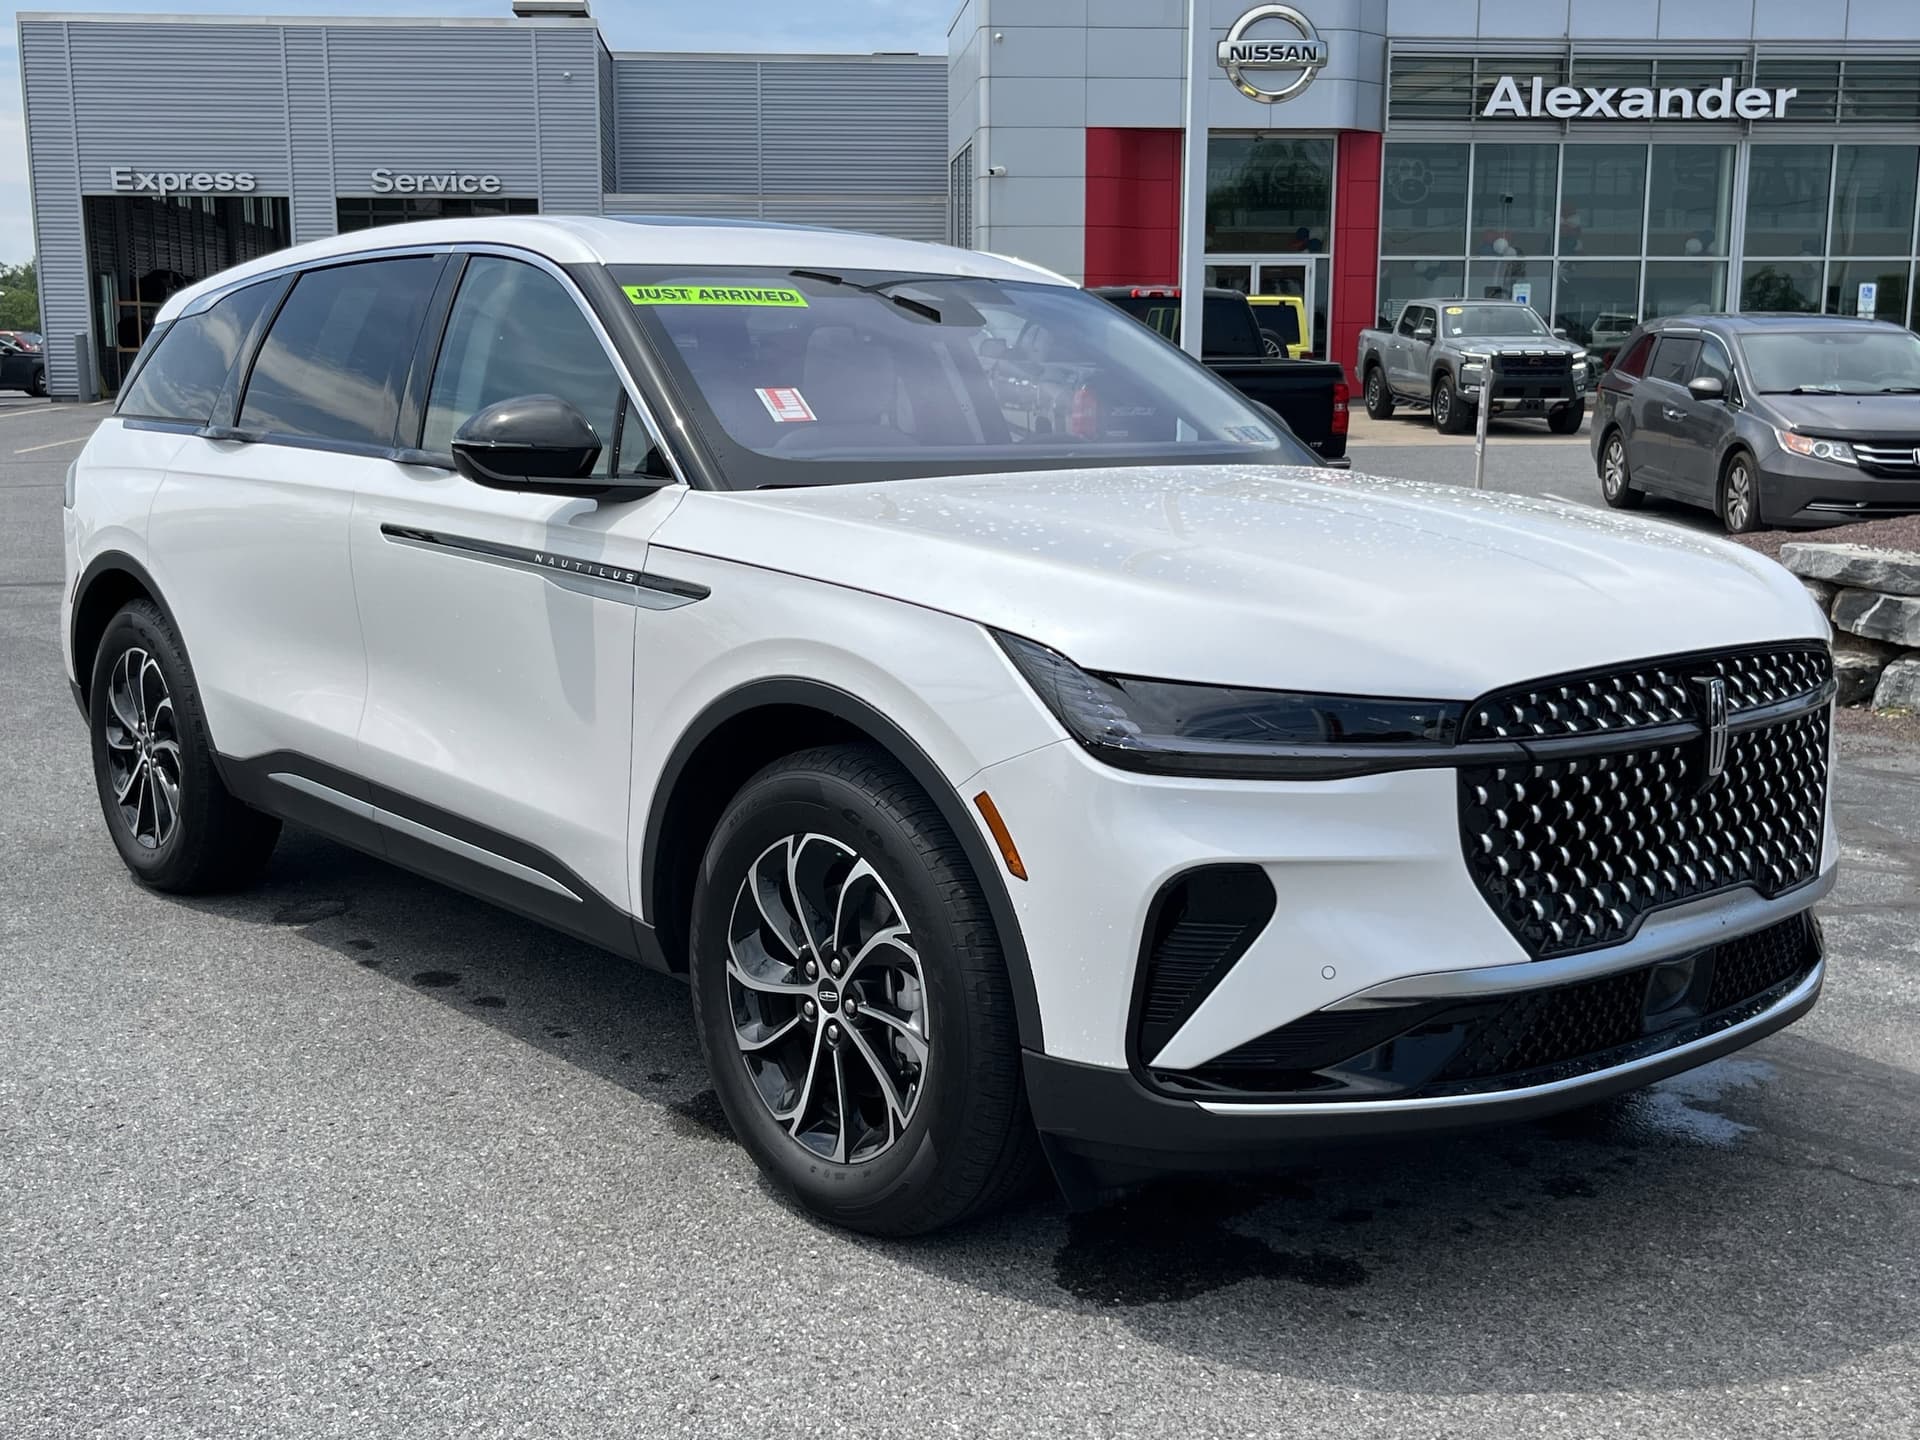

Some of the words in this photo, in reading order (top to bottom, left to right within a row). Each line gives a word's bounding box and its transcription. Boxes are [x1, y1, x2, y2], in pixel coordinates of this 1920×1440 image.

[1229, 45, 1317, 62] NISSAN
[1482, 76, 1798, 119] Alexander
[110, 166, 256, 195] Express
[370, 168, 502, 193] Service
[632, 288, 693, 301] JUST
[698, 289, 801, 304] ARRIVED
[534, 553, 635, 582] NAUTILUS
